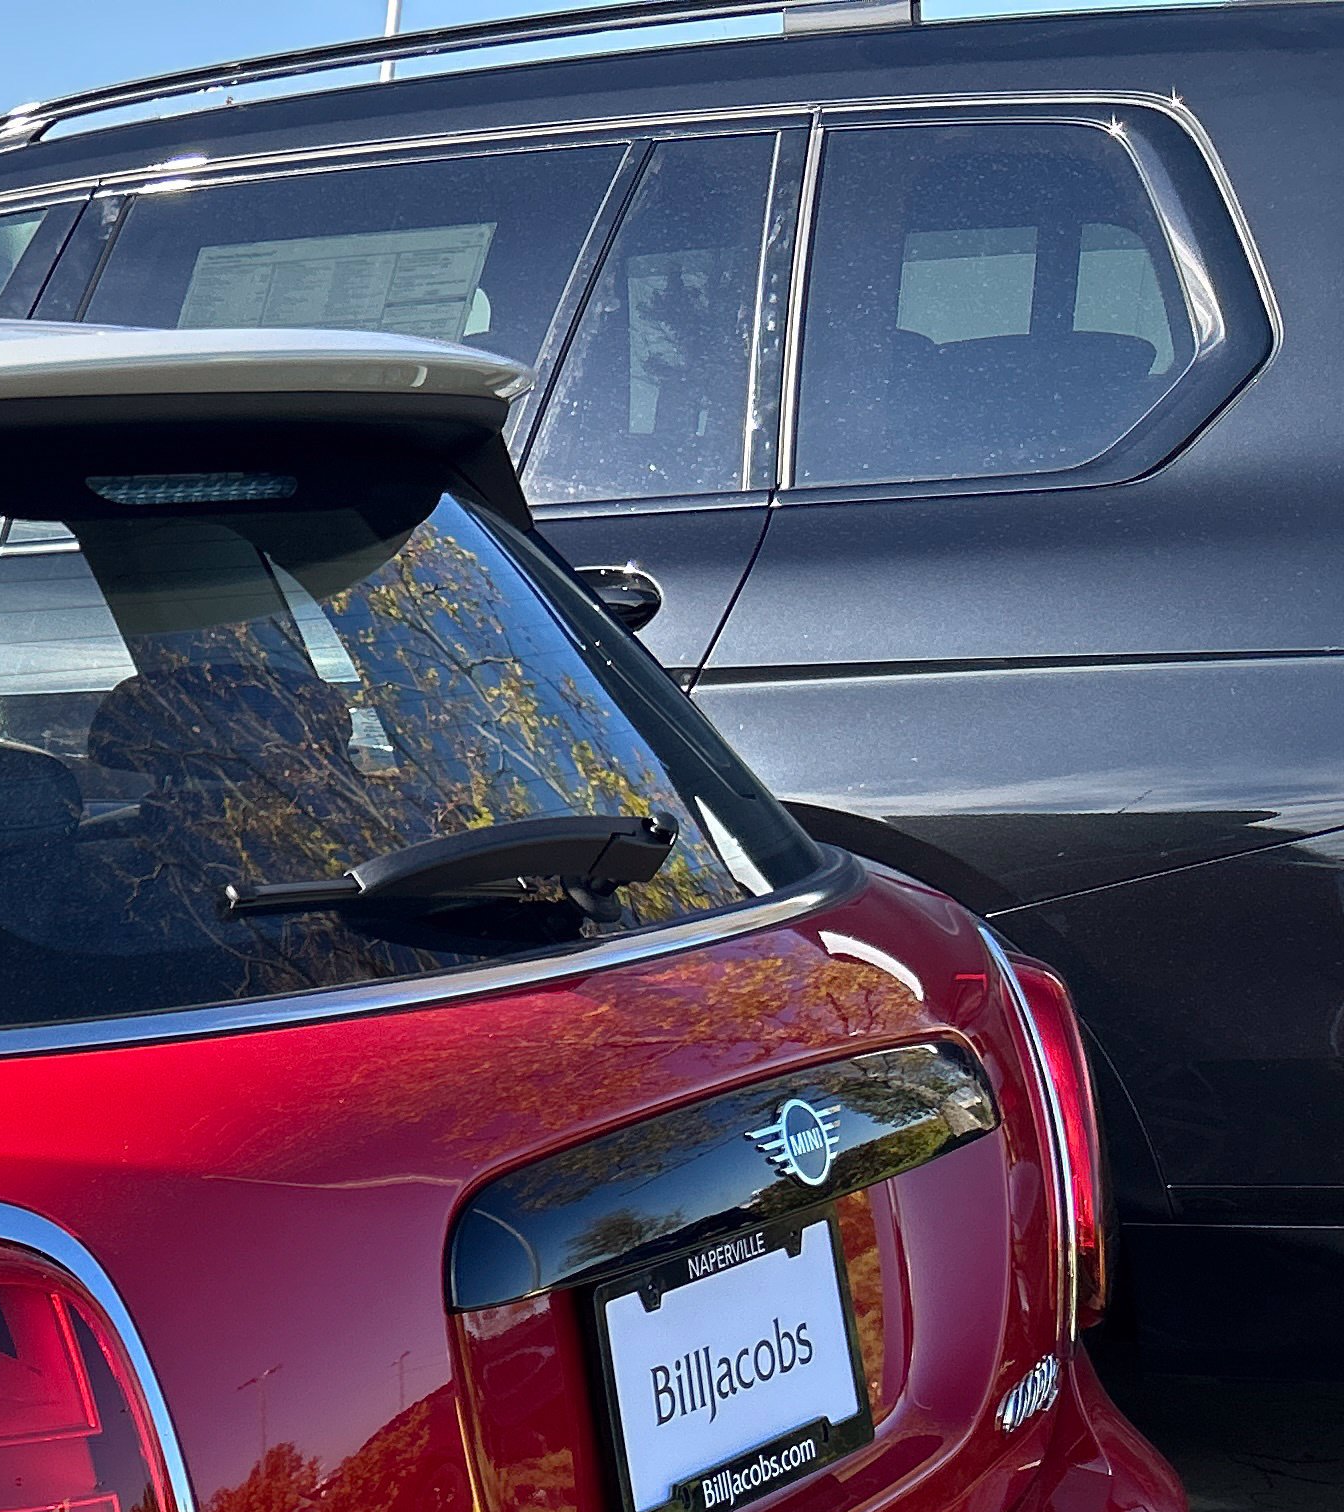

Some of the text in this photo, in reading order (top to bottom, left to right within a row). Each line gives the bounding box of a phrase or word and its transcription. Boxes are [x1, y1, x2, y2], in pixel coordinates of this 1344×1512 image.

[789, 1127, 824, 1157] MINI
[687, 1232, 766, 1280] NAPERVILLE
[650, 1317, 814, 1427] BillJacobs
[702, 1438, 816, 1509] BillJacobs.com
